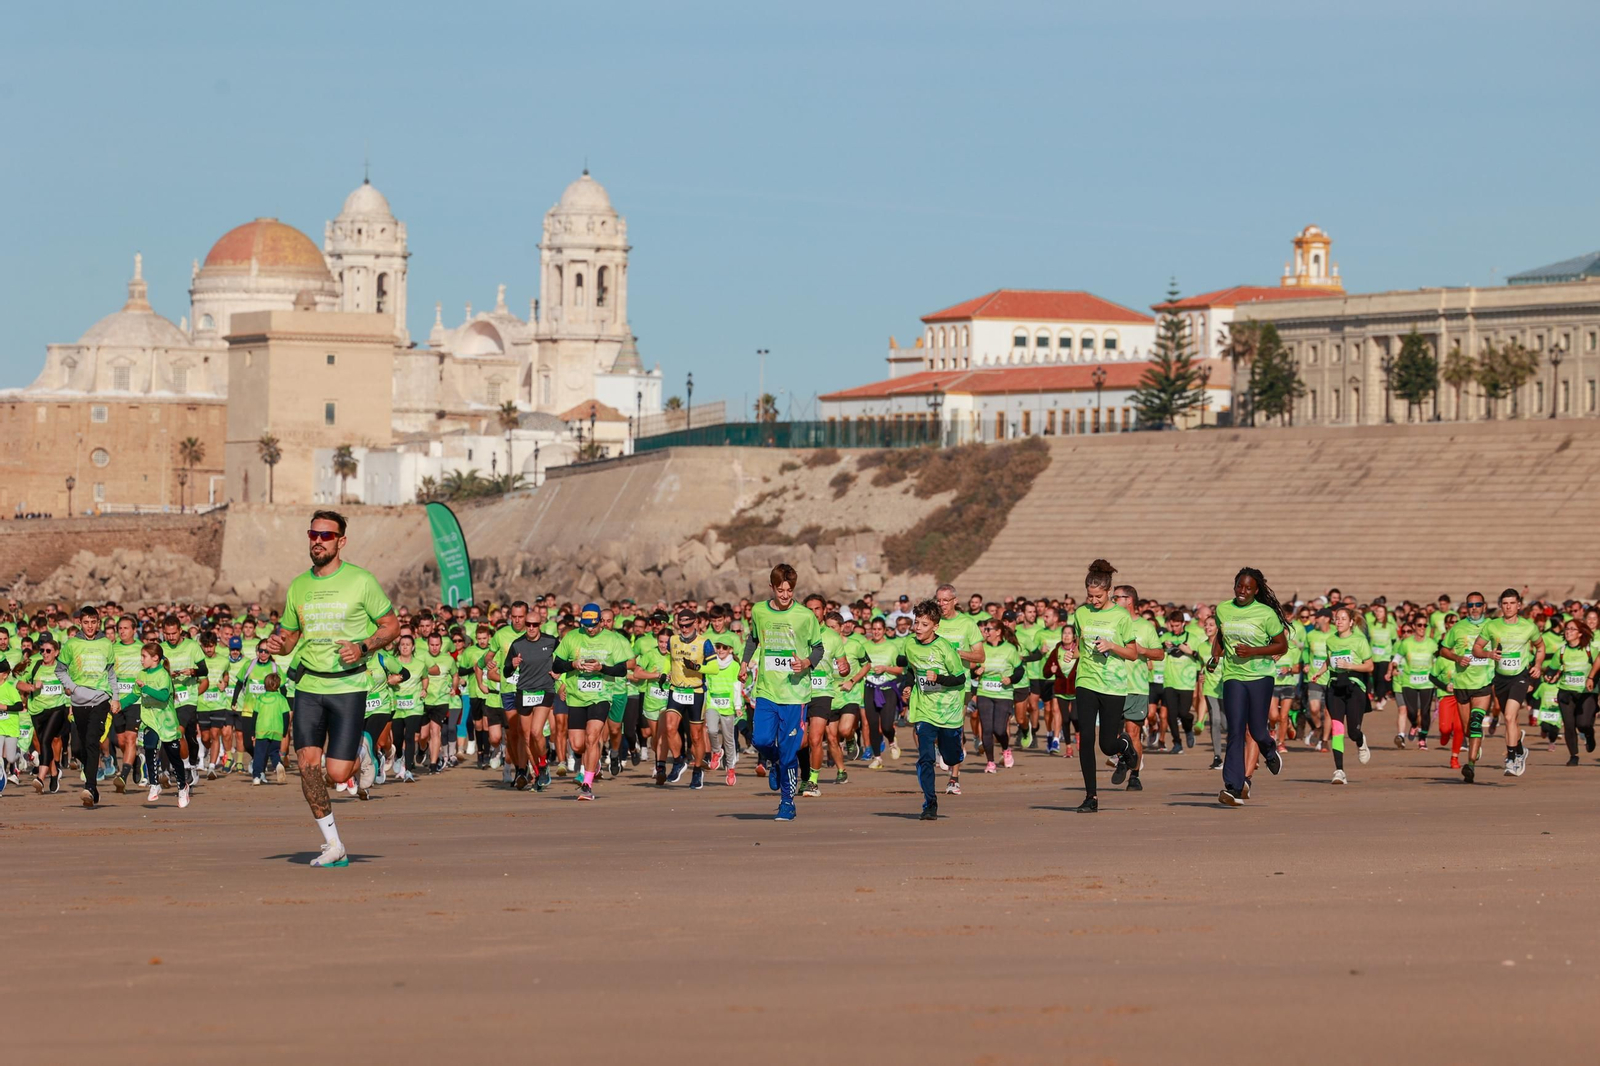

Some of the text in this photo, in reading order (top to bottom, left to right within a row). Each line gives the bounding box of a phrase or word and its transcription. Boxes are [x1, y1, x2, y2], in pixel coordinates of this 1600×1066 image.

[304, 601, 348, 610] En marcha
[304, 611, 334, 621] contra
[335, 610, 345, 620] el
[305, 620, 345, 632] cáncer
[774, 657, 793, 668] 941
[1502, 659, 1520, 667] 4231
[581, 681, 602, 689] 2497
[365, 699, 381, 708] 129
